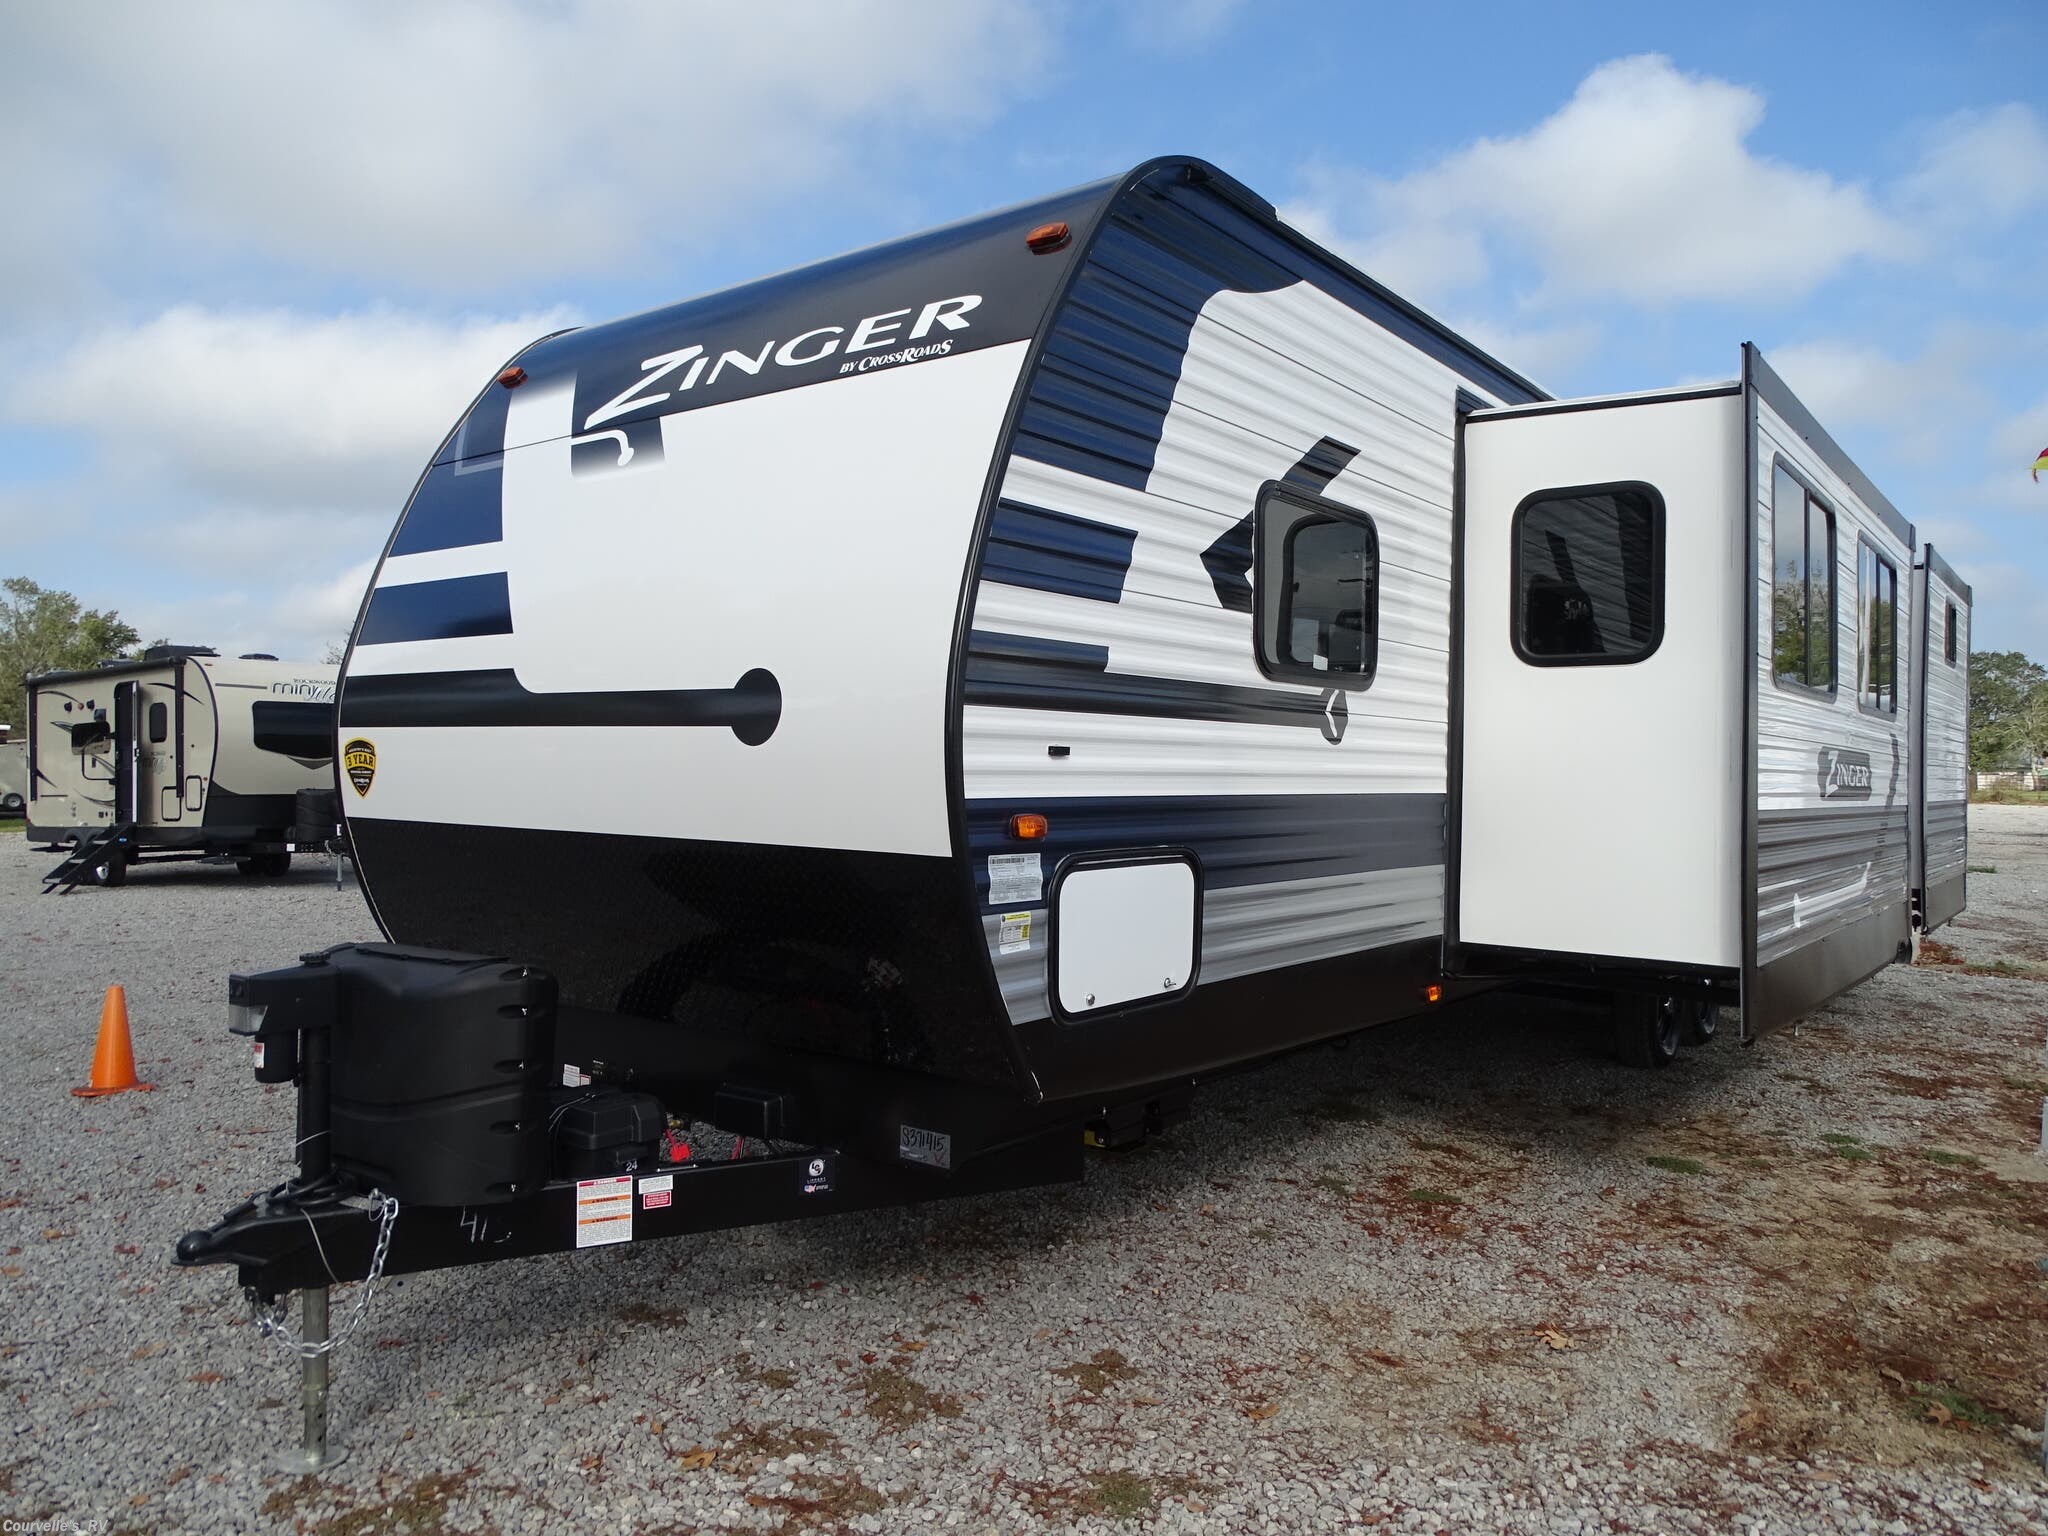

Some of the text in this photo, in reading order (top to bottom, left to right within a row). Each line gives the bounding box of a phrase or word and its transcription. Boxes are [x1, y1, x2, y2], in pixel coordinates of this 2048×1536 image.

[584, 295, 982, 430] ZINGER
[840, 361, 858, 374] BY
[347, 753, 374, 768] 3 YEAR
[1825, 750, 1869, 798] ZINGER
[626, 1160, 638, 1171] 24
